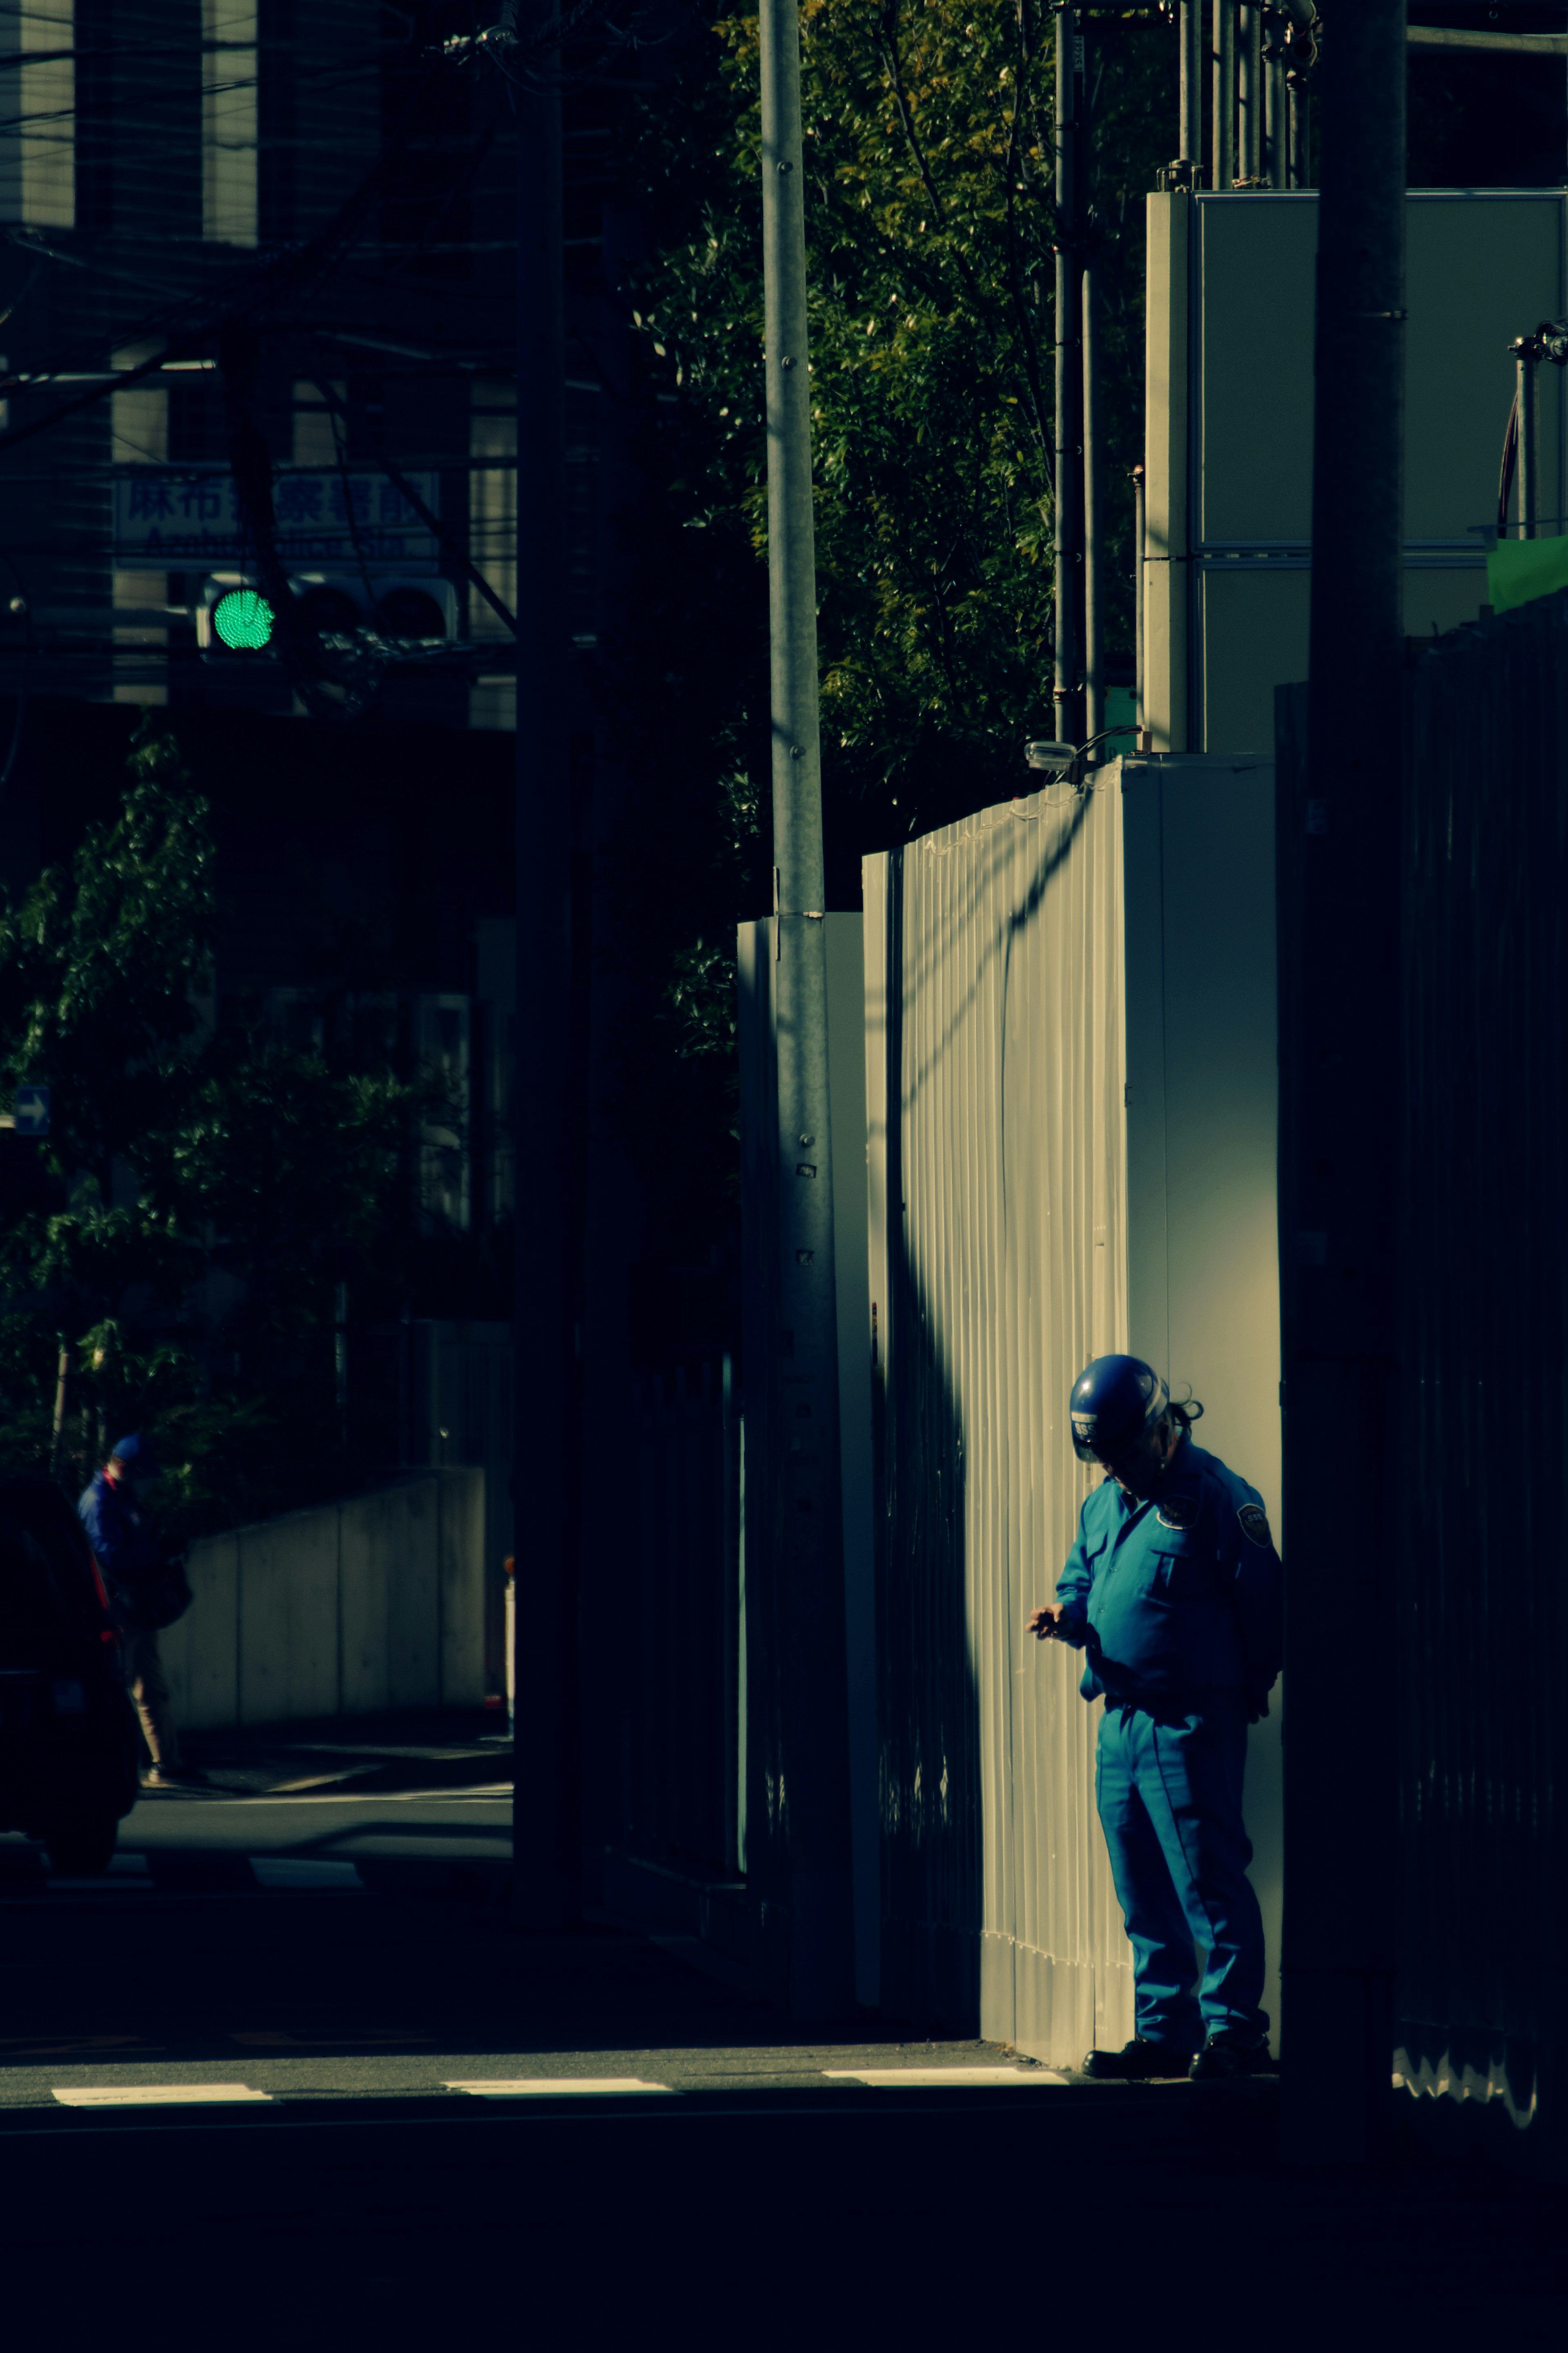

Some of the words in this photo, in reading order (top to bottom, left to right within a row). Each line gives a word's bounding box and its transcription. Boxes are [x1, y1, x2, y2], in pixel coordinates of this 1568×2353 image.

[129, 479, 423, 522] 麻布察署前
[266, 528, 340, 557] olice
[1075, 1422, 1095, 1435] SSS
